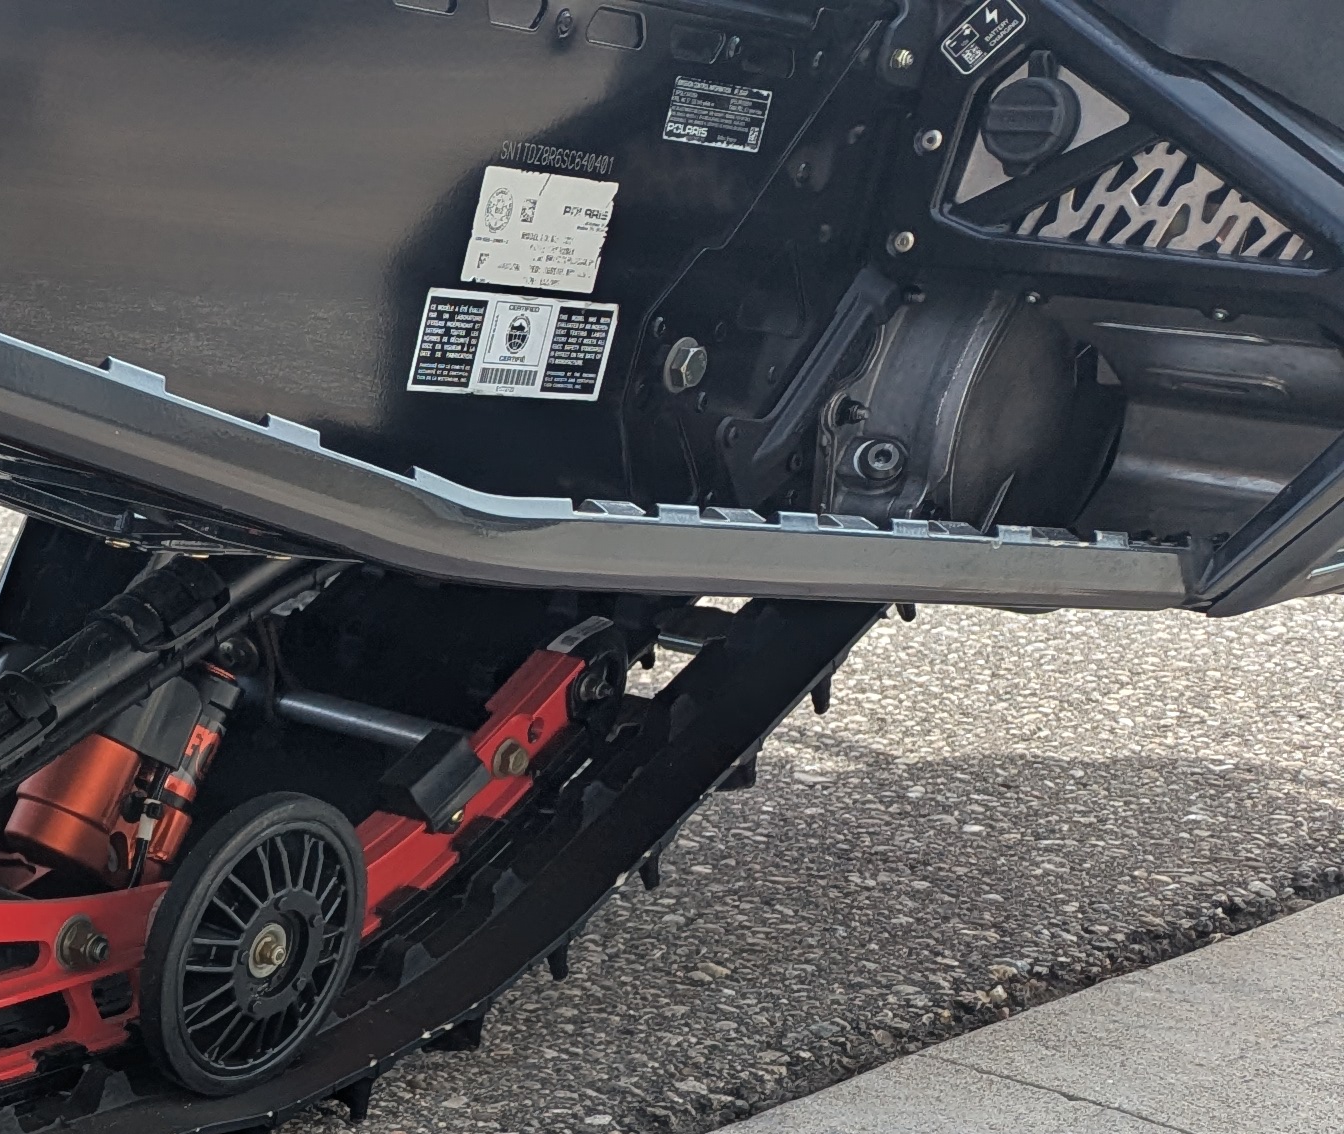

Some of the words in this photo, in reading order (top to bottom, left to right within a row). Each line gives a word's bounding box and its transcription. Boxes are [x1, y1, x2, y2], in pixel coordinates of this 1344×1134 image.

[984, 18, 1009, 42] BATTERY
[989, 19, 1019, 47] CHARGING
[666, 122, 709, 138] POLARIS
